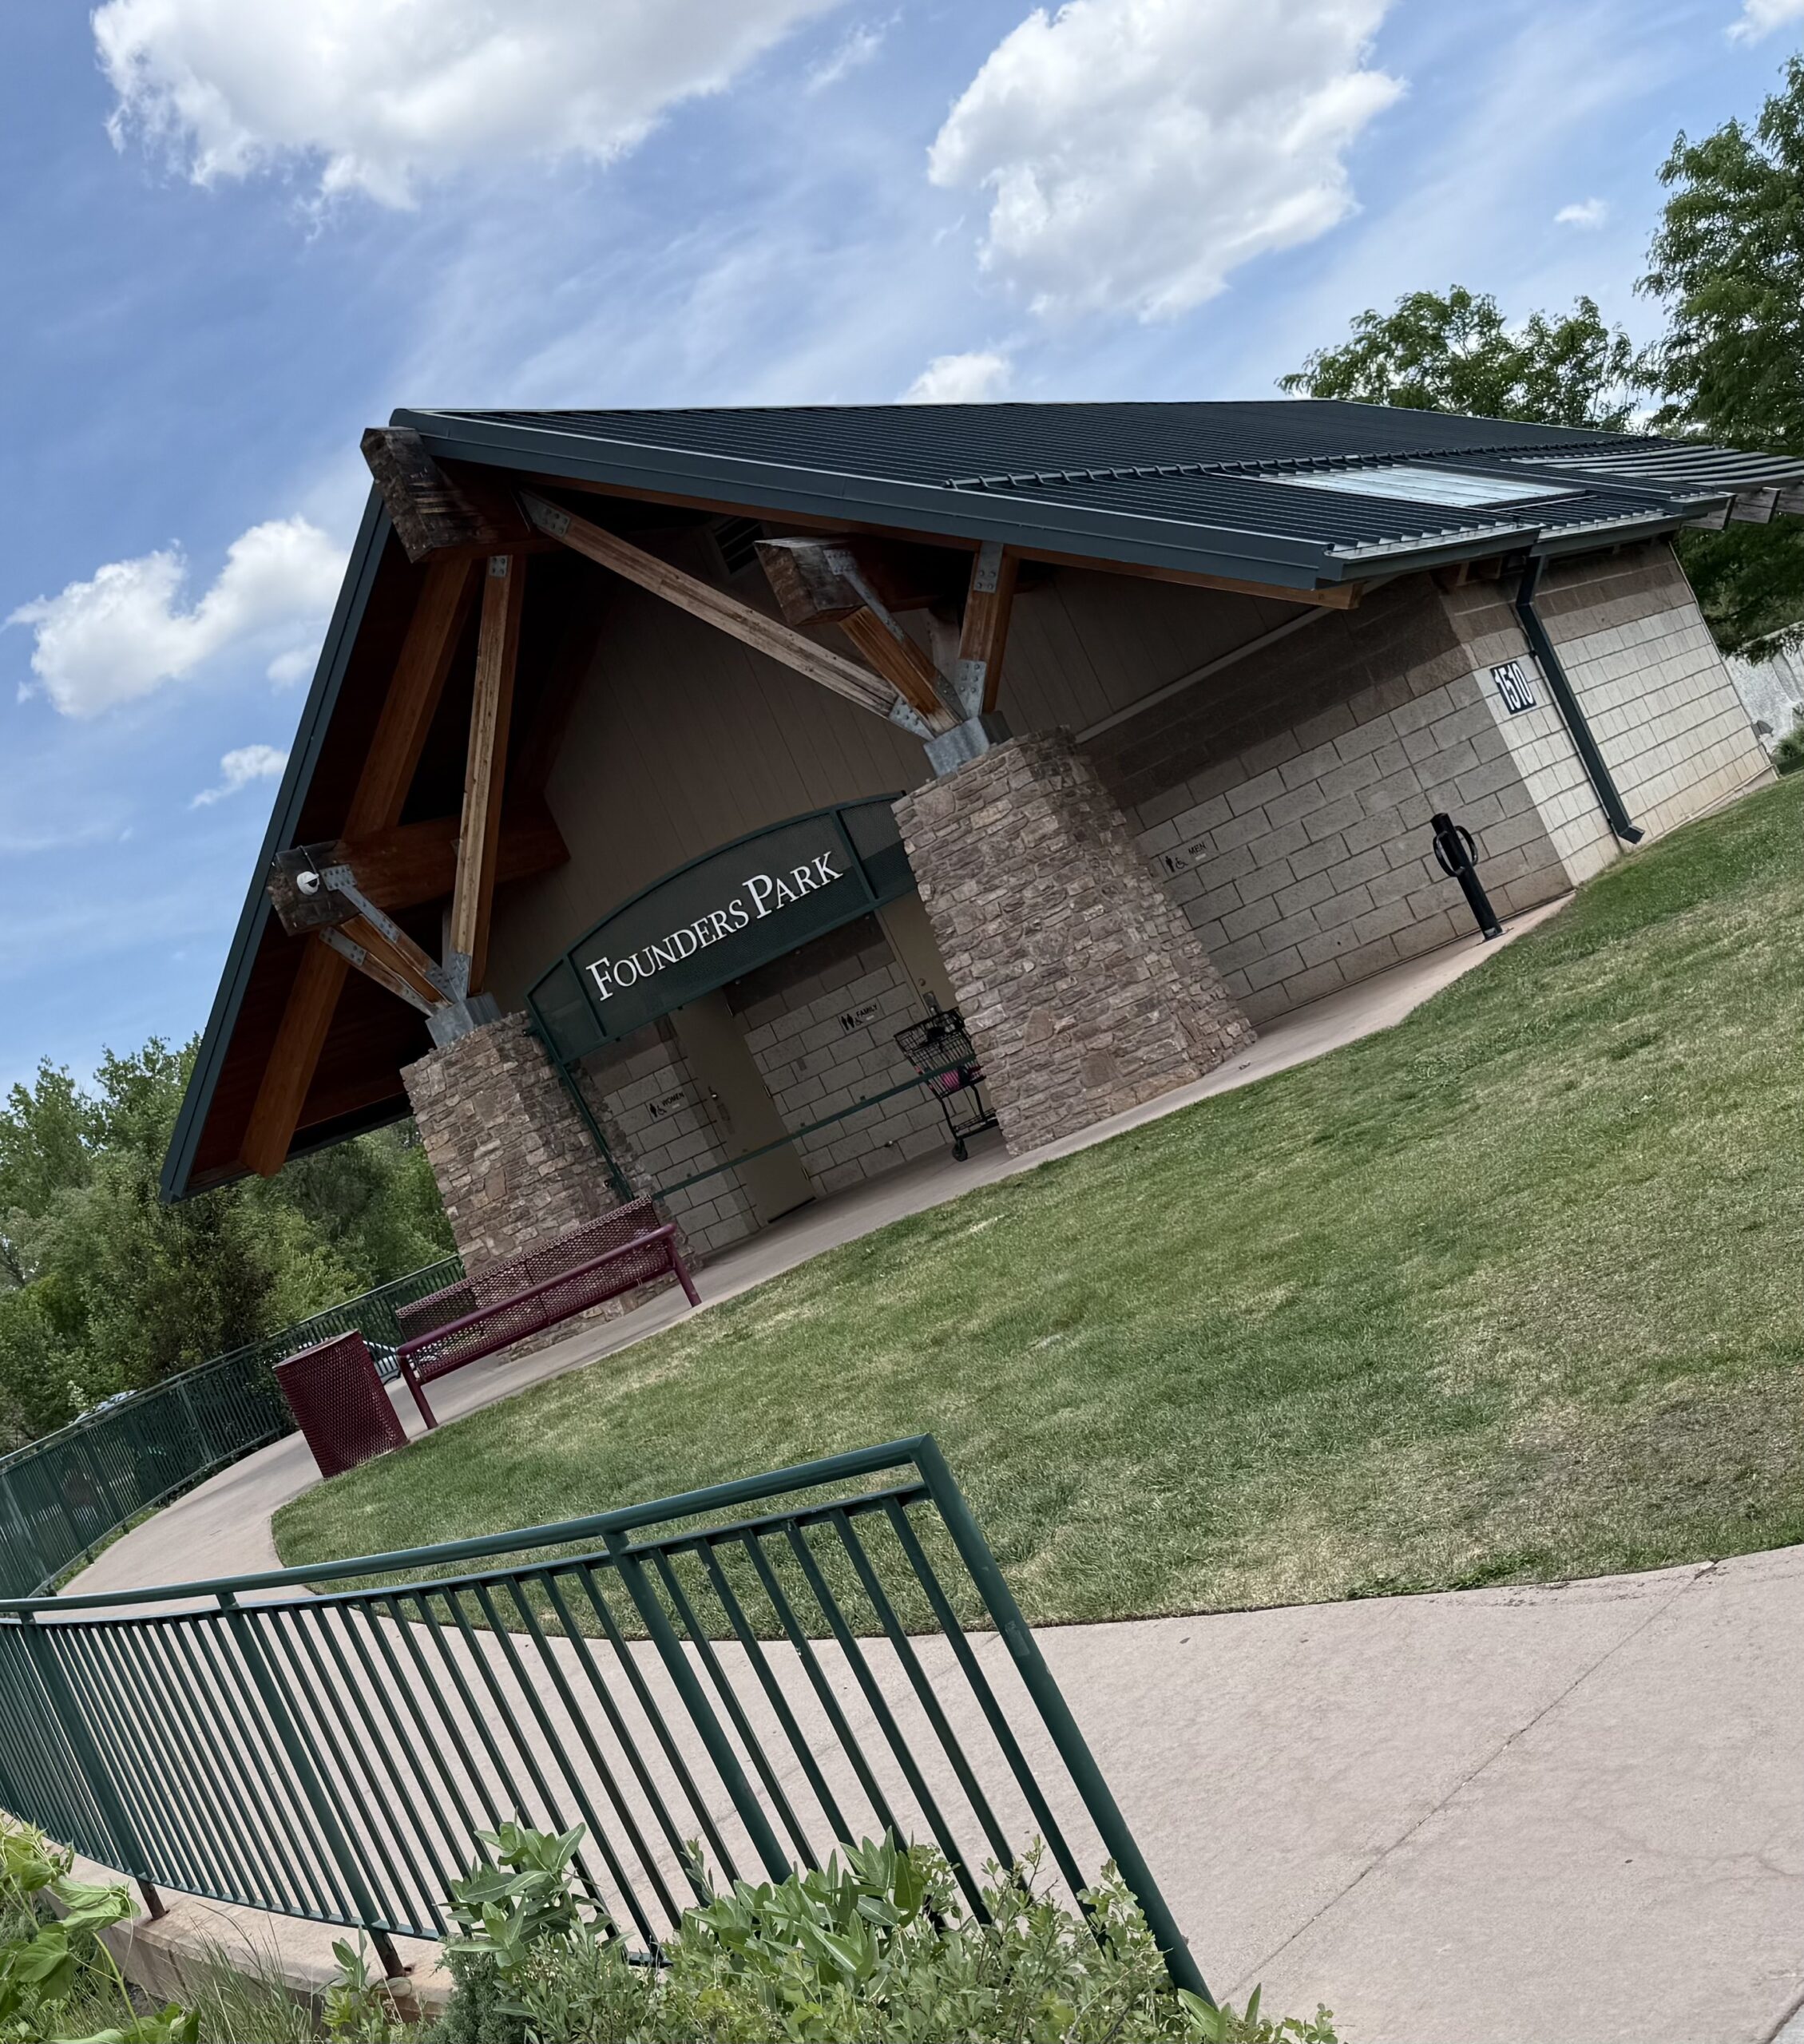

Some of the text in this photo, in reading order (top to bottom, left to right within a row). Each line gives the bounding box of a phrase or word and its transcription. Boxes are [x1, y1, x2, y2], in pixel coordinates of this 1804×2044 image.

[1494, 663, 1533, 711] 1510
[1188, 842, 1207, 856] MEN
[585, 851, 844, 1001] FOUNDERS PARK
[856, 1003, 878, 1017] FAMILY
[662, 1091, 684, 1106] WOMEN
